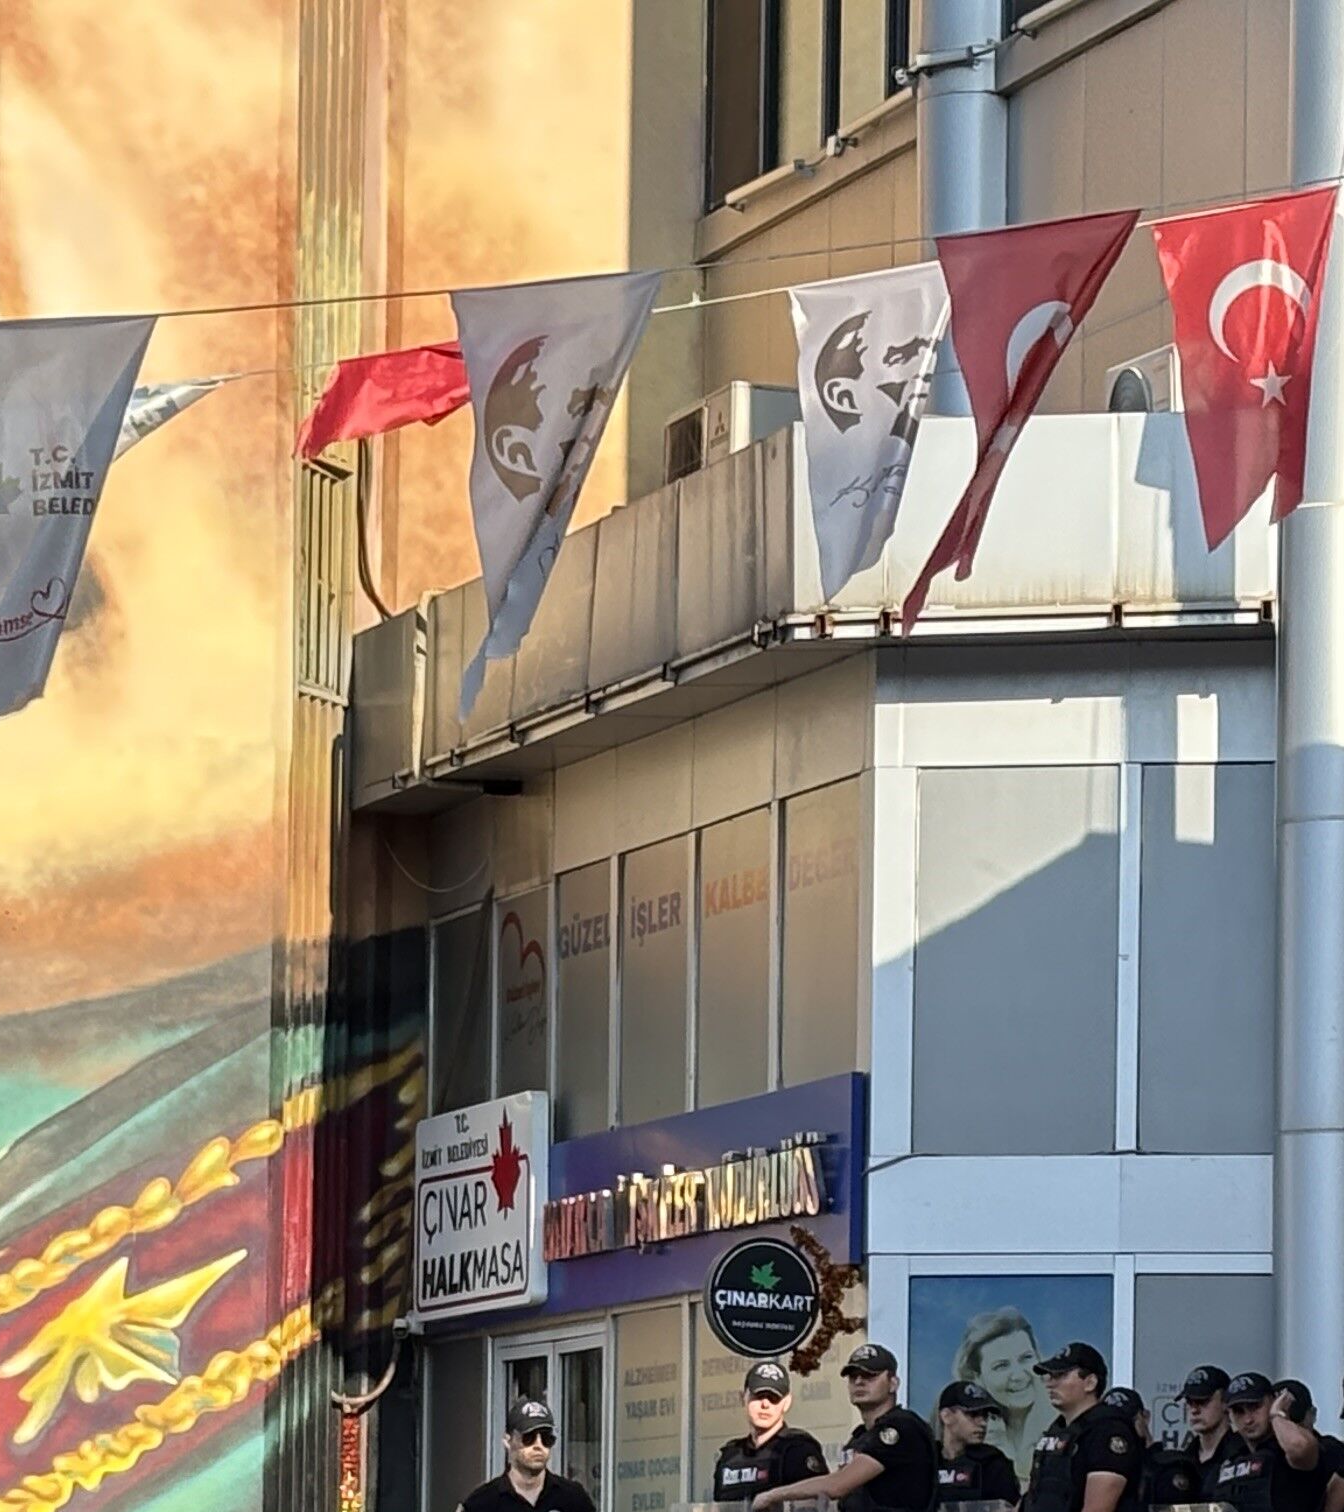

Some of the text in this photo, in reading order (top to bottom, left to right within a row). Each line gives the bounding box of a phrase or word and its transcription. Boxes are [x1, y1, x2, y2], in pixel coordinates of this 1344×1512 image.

[29, 445, 76, 466] T.C.
[31, 467, 95, 493] İZMİT
[558, 911, 611, 961] GÜZEL
[630, 890, 682, 948] İŞLER
[422, 1180, 488, 1245] ÇINAR
[422, 1239, 525, 1300] HALKMASA
[715, 1289, 815, 1312] ÇINARKART
